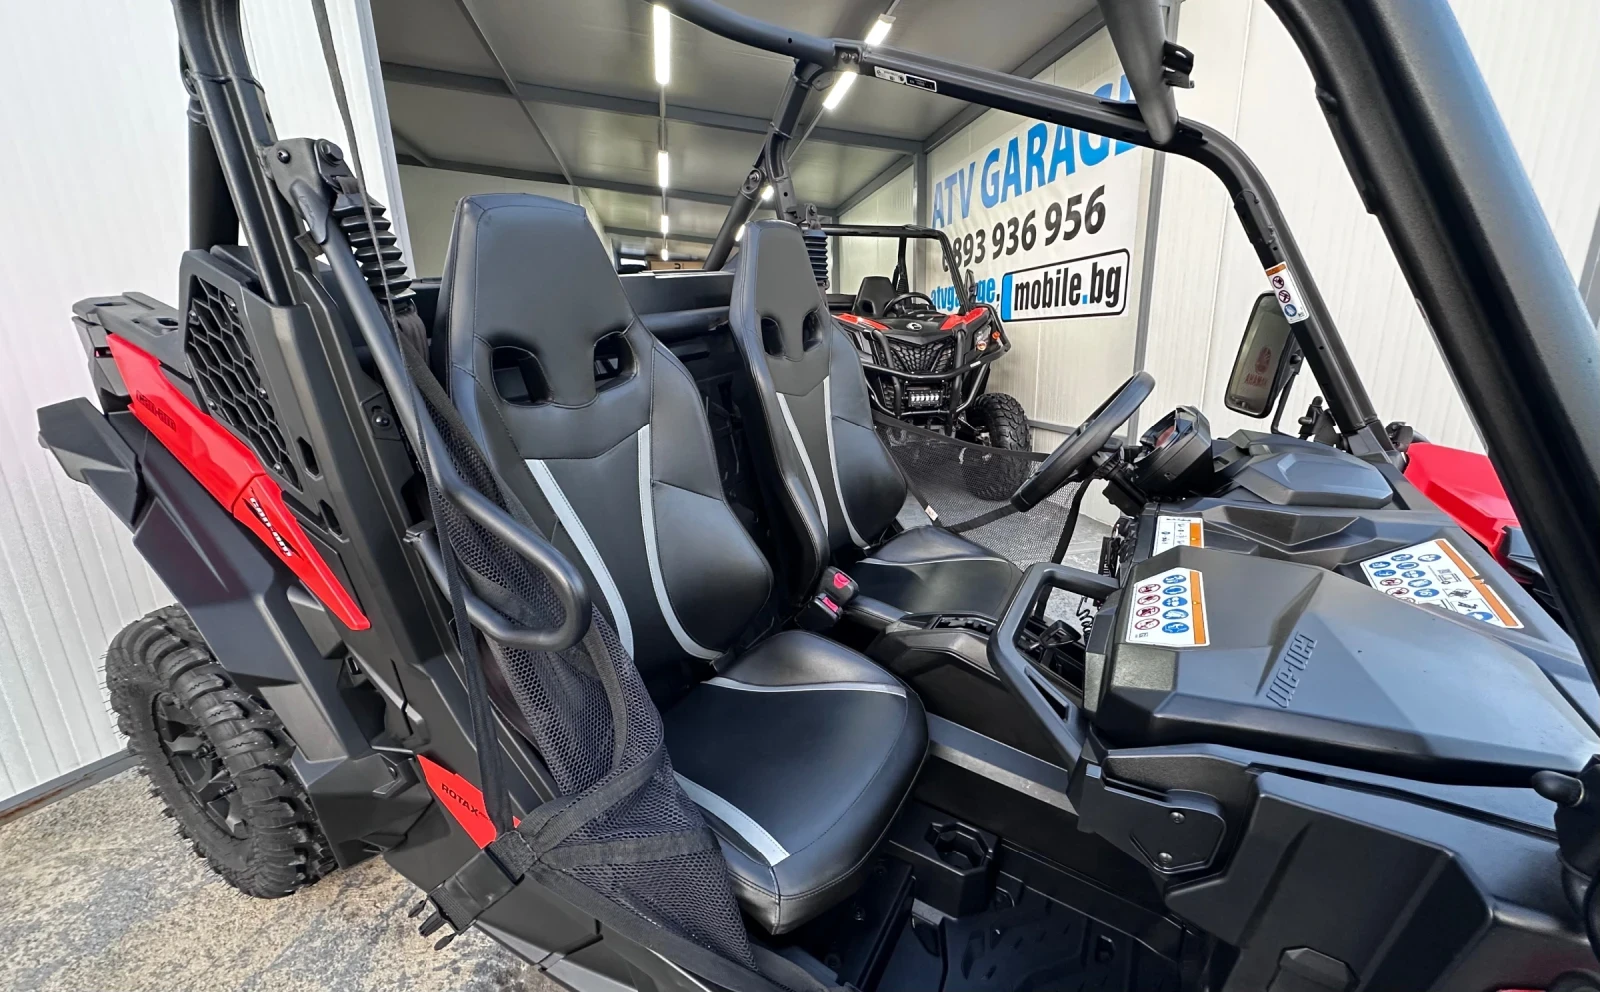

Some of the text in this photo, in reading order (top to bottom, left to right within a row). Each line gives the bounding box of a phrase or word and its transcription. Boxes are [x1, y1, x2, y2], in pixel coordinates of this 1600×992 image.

[932, 161, 976, 229] ATV
[992, 209, 1037, 260] 936
[1044, 184, 1106, 246] 956
[1013, 261, 1122, 312] mobile.bg
[441, 782, 479, 817] ROTAX
